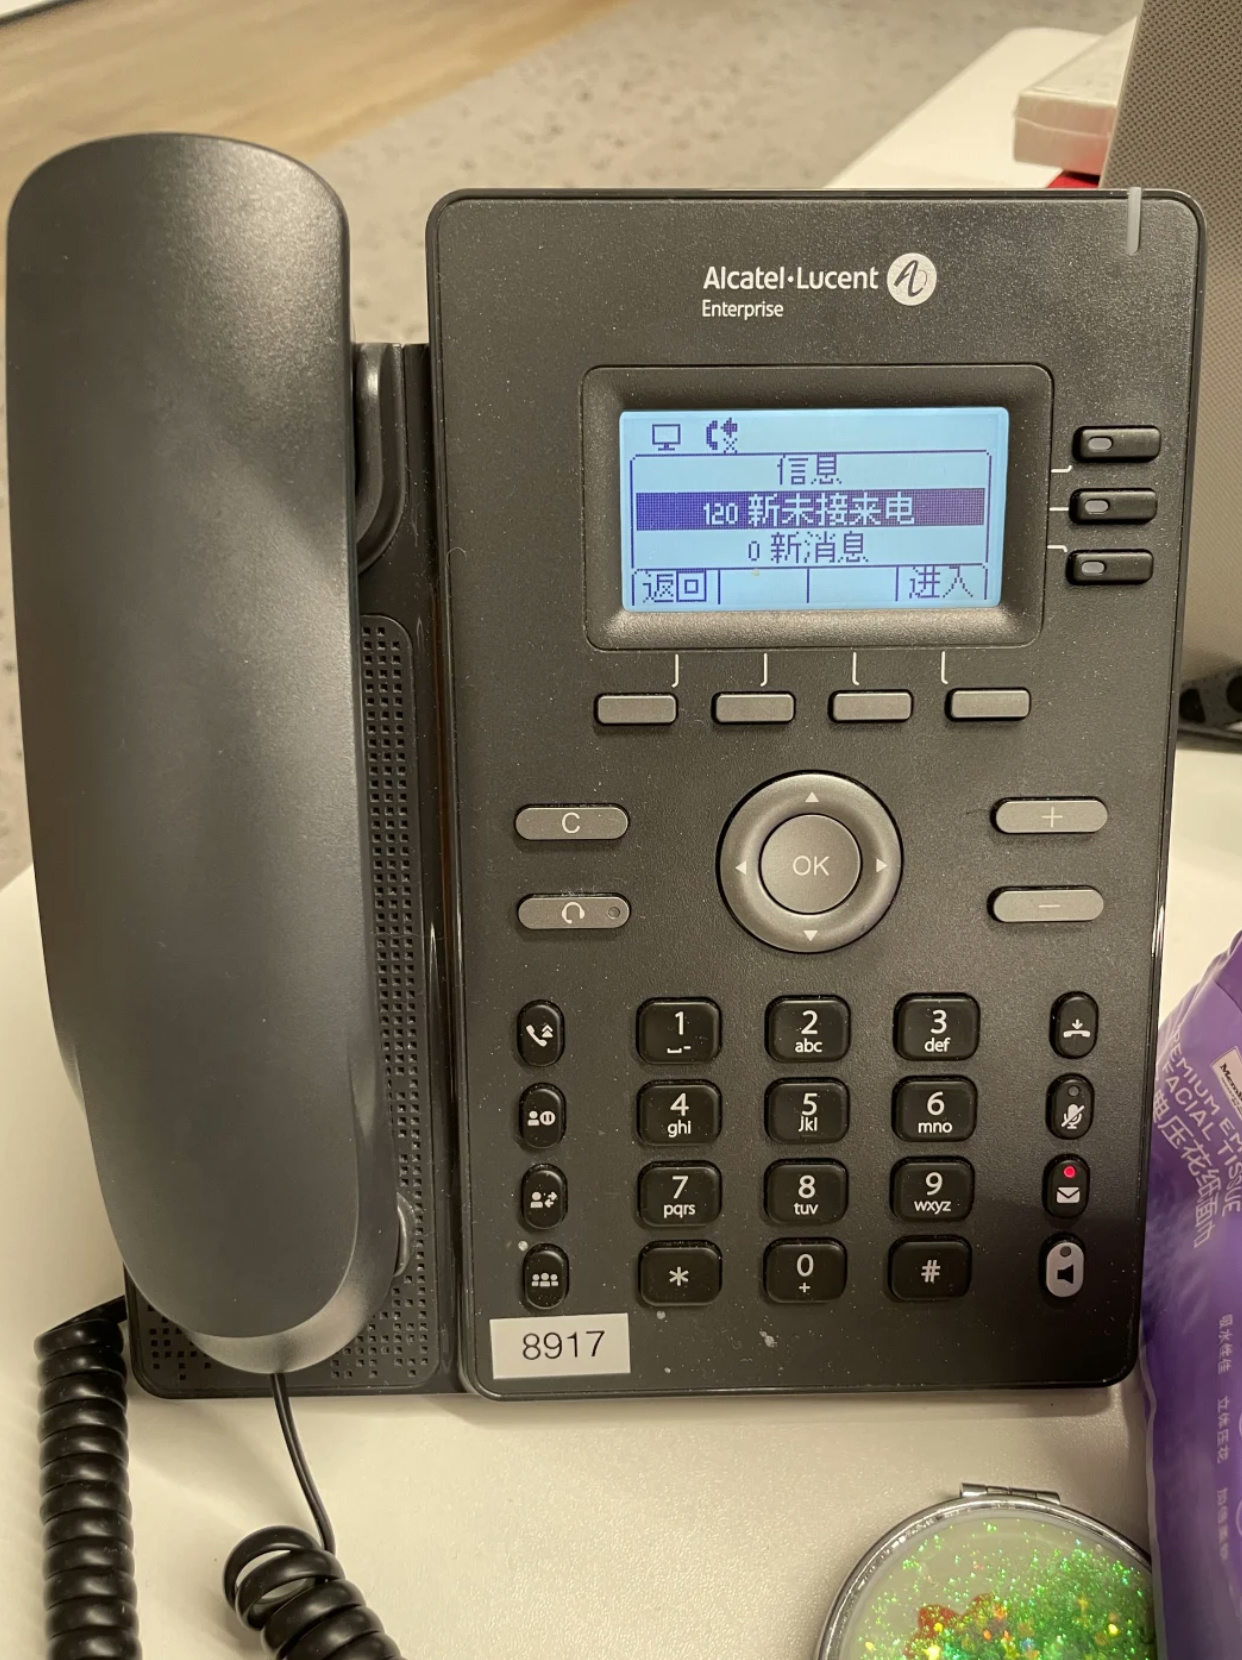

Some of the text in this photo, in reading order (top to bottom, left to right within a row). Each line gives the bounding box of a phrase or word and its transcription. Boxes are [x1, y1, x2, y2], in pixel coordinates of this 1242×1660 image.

[702, 299, 784, 320] Enterprise
[777, 453, 842, 485] 信息
[703, 492, 915, 526] 120 新未接来电
[770, 531, 869, 563] 新消息
[642, 568, 707, 602] 返回
[909, 565, 974, 599] 进入
[561, 812, 581, 834] C
[792, 855, 830, 877] OK
[675, 1011, 685, 1036] 1
[801, 1010, 819, 1035] 2
[931, 1009, 948, 1035] 3
[794, 1039, 823, 1053] abc
[924, 1037, 951, 1053] def
[670, 1093, 689, 1117] 4
[801, 1092, 818, 1116] 5
[927, 1092, 945, 1116] 6
[667, 1120, 692, 1138] ghi
[798, 1117, 818, 1133] jkl
[918, 1121, 953, 1134] mno
[671, 1175, 689, 1199] 7
[798, 1174, 816, 1199] 8
[925, 1172, 943, 1196] 9
[663, 1202, 696, 1219] pqrs
[793, 1202, 819, 1215] tuv
[914, 1199, 951, 1213] wxyz
[796, 1253, 814, 1277] 0
[522, 1330, 605, 1360] 8917
